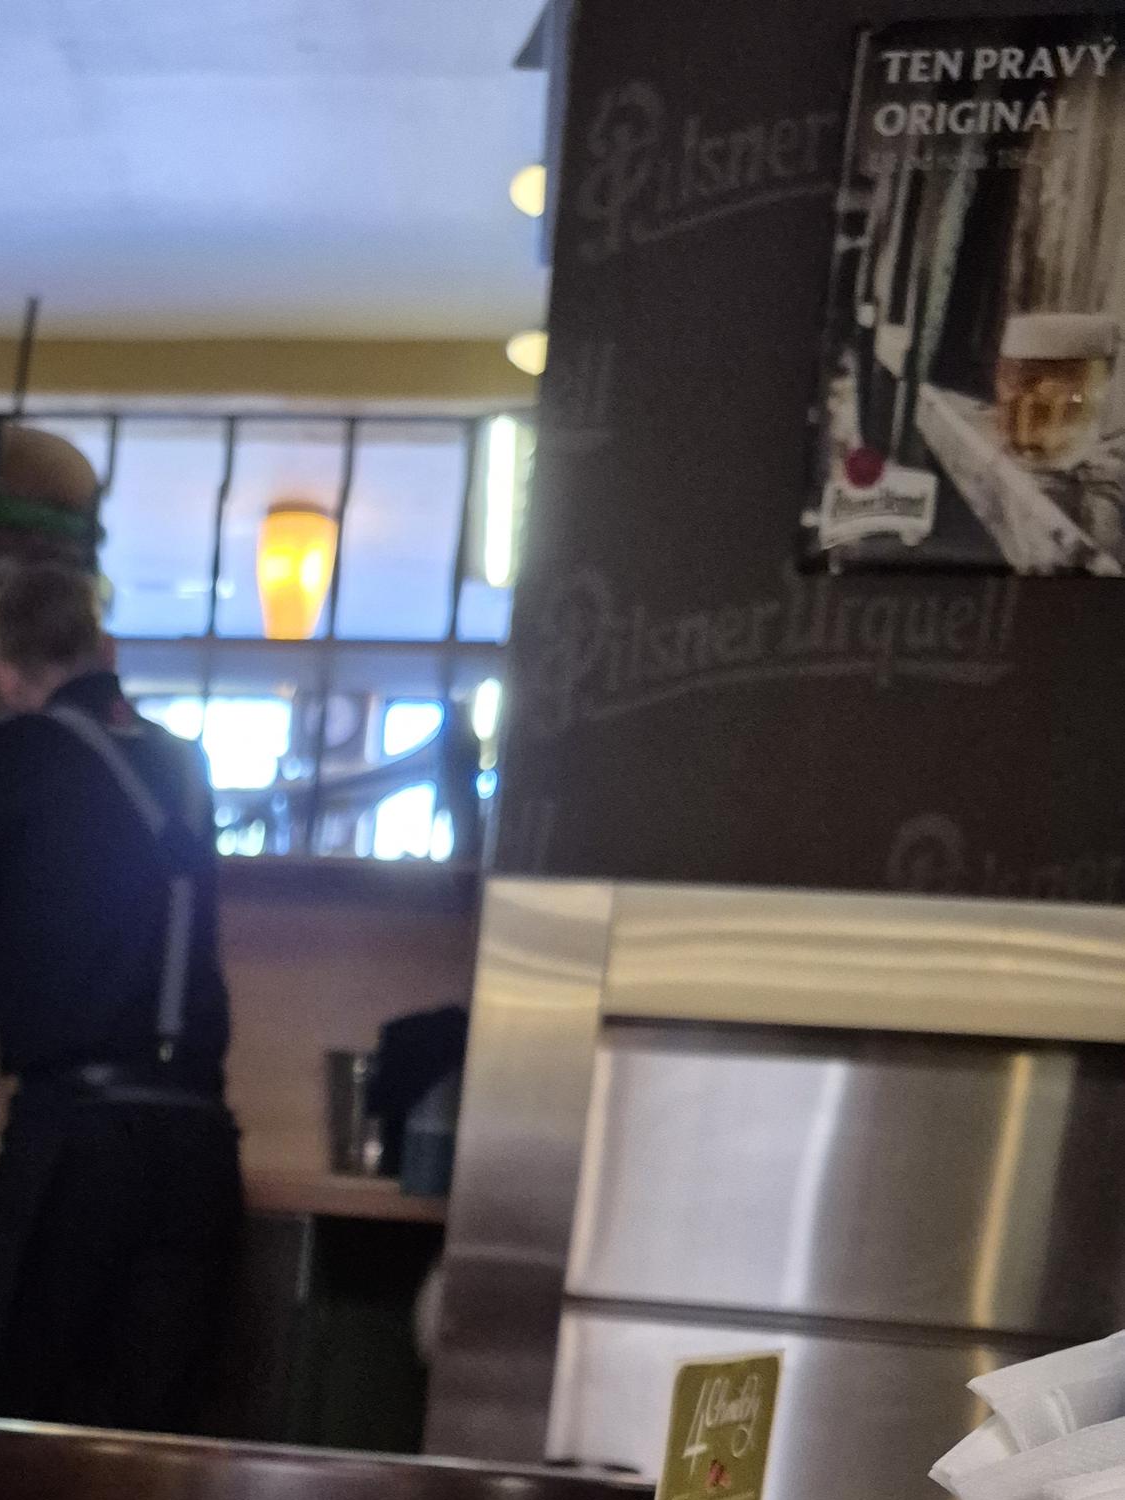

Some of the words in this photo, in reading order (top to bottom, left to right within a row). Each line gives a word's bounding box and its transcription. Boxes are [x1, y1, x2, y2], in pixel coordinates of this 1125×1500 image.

[873, 91, 1077, 138] ORIGINÁL
[879, 48, 965, 85] TEN
[972, 36, 1117, 81] PRAVÝ
[576, 79, 838, 265] Pilsner
[533, 563, 780, 738] Pilsner
[773, 559, 1018, 690] Urquell
